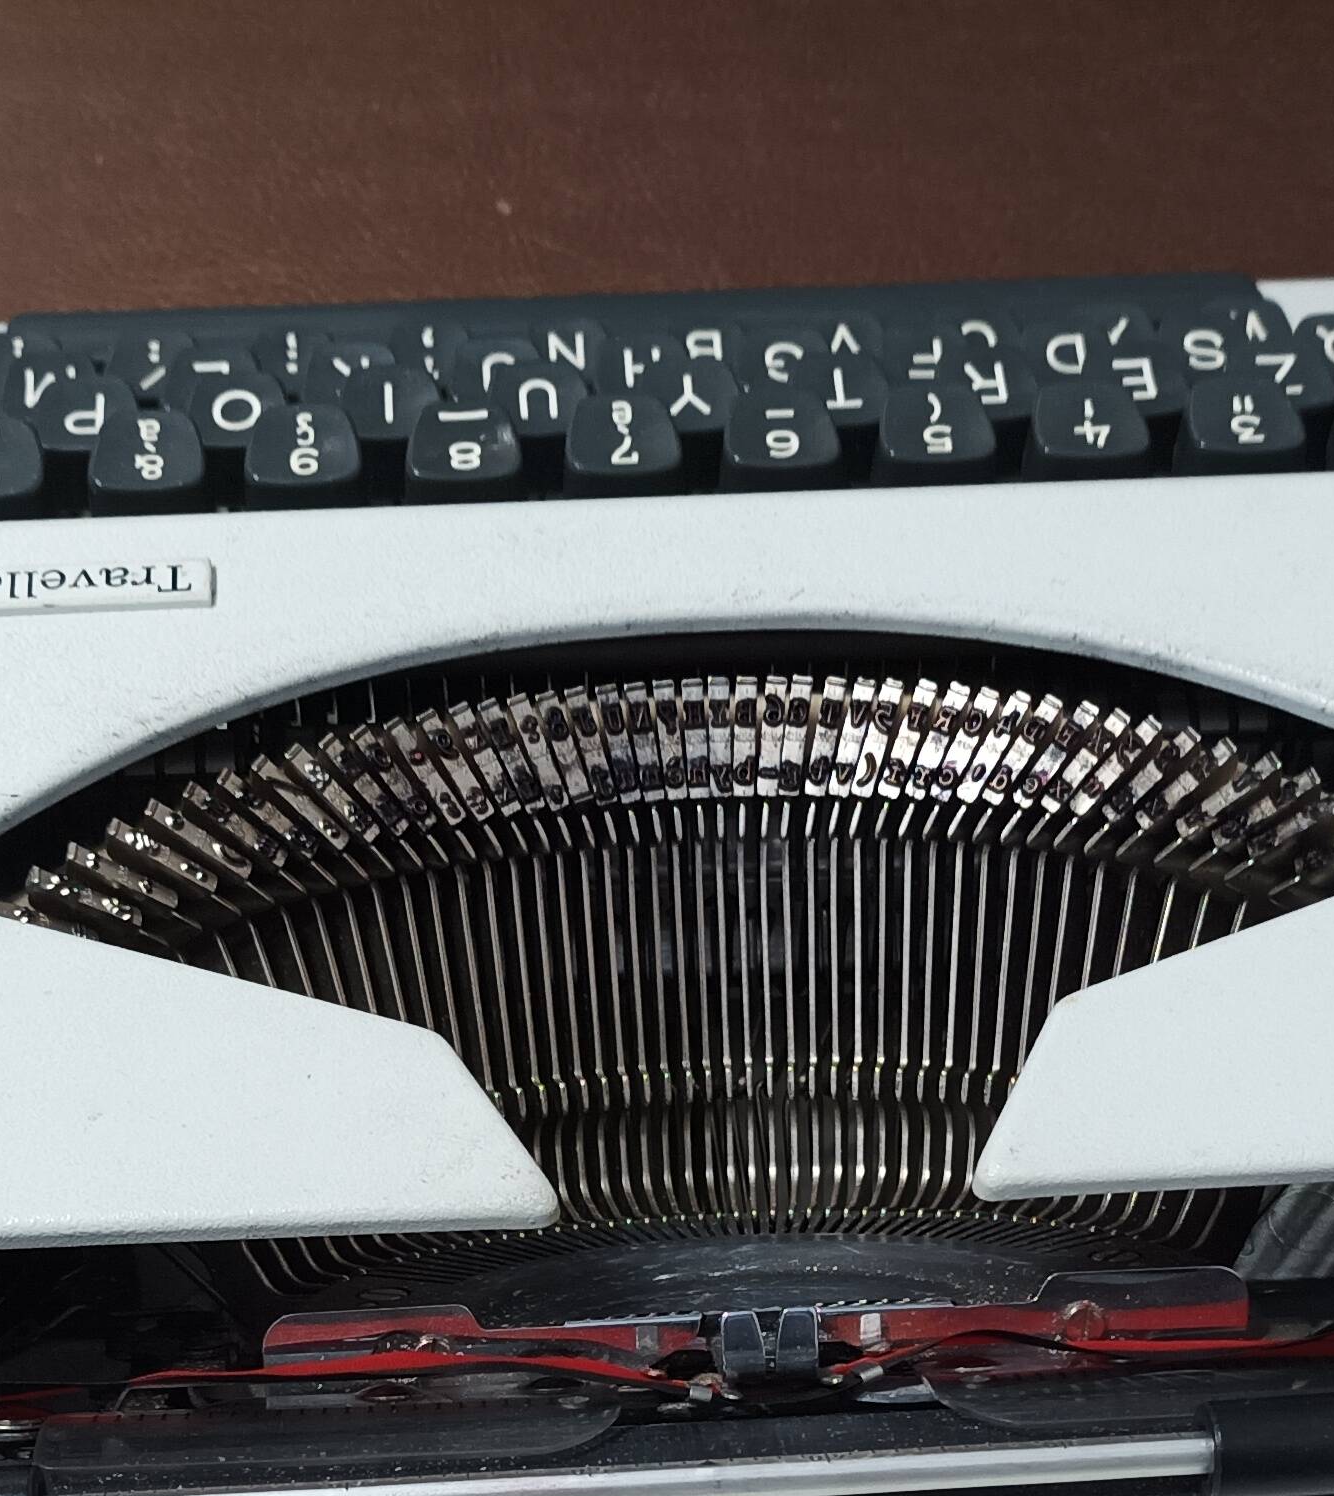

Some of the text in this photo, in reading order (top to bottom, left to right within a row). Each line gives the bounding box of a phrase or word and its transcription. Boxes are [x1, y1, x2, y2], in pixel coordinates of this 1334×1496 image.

[547, 331, 586, 371] N
[1045, 332, 1087, 375] D
[1183, 329, 1226, 370] S
[518, 378, 559, 421] U
[669, 373, 712, 417] Y
[826, 367, 863, 410] T
[963, 361, 1009, 405] R
[1111, 357, 1158, 401] E
[63, 392, 106, 436] P
[211, 388, 262, 432] O
[448, 441, 482, 471] 8
